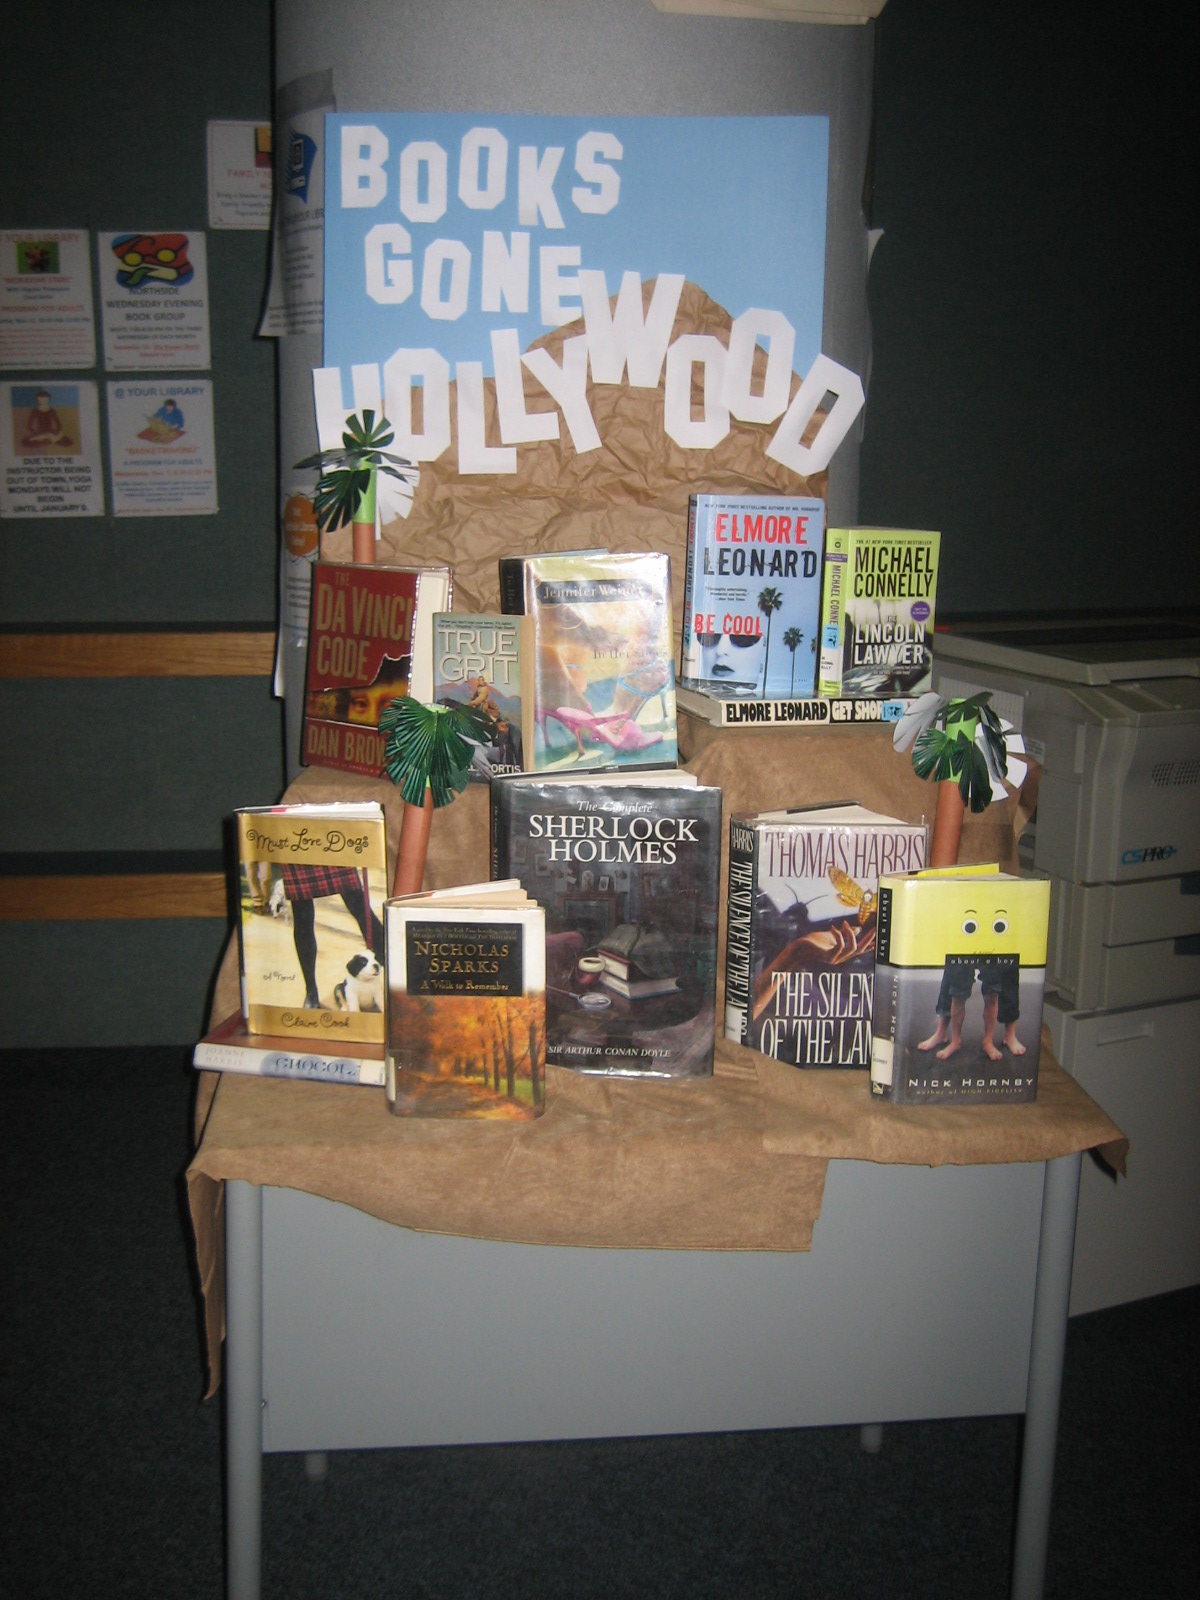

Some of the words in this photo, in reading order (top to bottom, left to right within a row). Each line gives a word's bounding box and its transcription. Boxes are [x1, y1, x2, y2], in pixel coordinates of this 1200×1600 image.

[340, 125, 624, 229] BOOKS
[365, 223, 584, 327] GONE
[129, 287, 179, 295] NORTHSIDE
[106, 300, 161, 308] WEDNESDAY
[164, 300, 204, 308] EVENING
[125, 313, 151, 321] BOOK
[153, 313, 186, 321] GROUP
[312, 269, 866, 478] HOLLYWOOD
[127, 387, 157, 397] YOUR
[159, 386, 205, 396] LIBRARY
[6, 477, 25, 485] OUT
[8, 486, 51, 494] MONDAYS
[74, 485, 92, 493] NOT
[715, 513, 809, 545] ELMORE
[686, 550, 694, 593] LEONARD
[703, 547, 817, 578] LEONARD
[855, 546, 934, 573] MICHAEL
[335, 572, 350, 587] THE
[543, 585, 598, 599] Jennifer
[833, 565, 841, 597] MICHAEL
[853, 572, 933, 597] CONNELLY
[316, 583, 347, 633] DA
[694, 613, 716, 634] BE
[723, 613, 764, 637] COOL
[854, 623, 926, 644] LINCOLN
[438, 629, 519, 656] TRUE
[854, 644, 924, 664] LAWYER
[316, 635, 371, 681] CODE
[439, 654, 519, 685] GRIT
[725, 701, 771, 722] ELMORE
[774, 700, 828, 721] LEONARD
[832, 700, 853, 720] GET
[308, 725, 340, 758] DAN
[576, 800, 598, 812] The
[602, 801, 652, 815] Complete
[246, 829, 290, 851] Must
[290, 828, 323, 852] Love
[323, 830, 369, 853] Dogs
[529, 814, 699, 842] SHERLOCK
[731, 826, 754, 852] HARRIS
[548, 839, 677, 865] HOLMES
[765, 832, 850, 880] THOMAS
[853, 832, 925, 879] HARRIS
[731, 861, 753, 890] THE
[729, 889, 752, 943] SILENCE
[414, 941, 509, 957] NICHOLAS
[997, 957, 1015, 966] boy
[273, 971, 296, 981] Novel
[428, 958, 499, 973] SPARKS
[420, 980, 429, 989] A
[430, 979, 454, 990] Walk
[455, 982, 463, 990] to
[465, 980, 509, 990] Remember
[771, 971, 813, 1018] THE
[319, 1012, 351, 1028] Cook
[548, 1045, 563, 1055] SIR
[564, 1045, 602, 1056] ARTHUR
[605, 1046, 639, 1057] CONAN
[641, 1047, 671, 1058] DOYLE
[760, 1019, 787, 1060] OF
[792, 1019, 833, 1064] THE
[908, 1078, 952, 1088] NICK
[962, 1078, 1034, 1087] HORNBY
